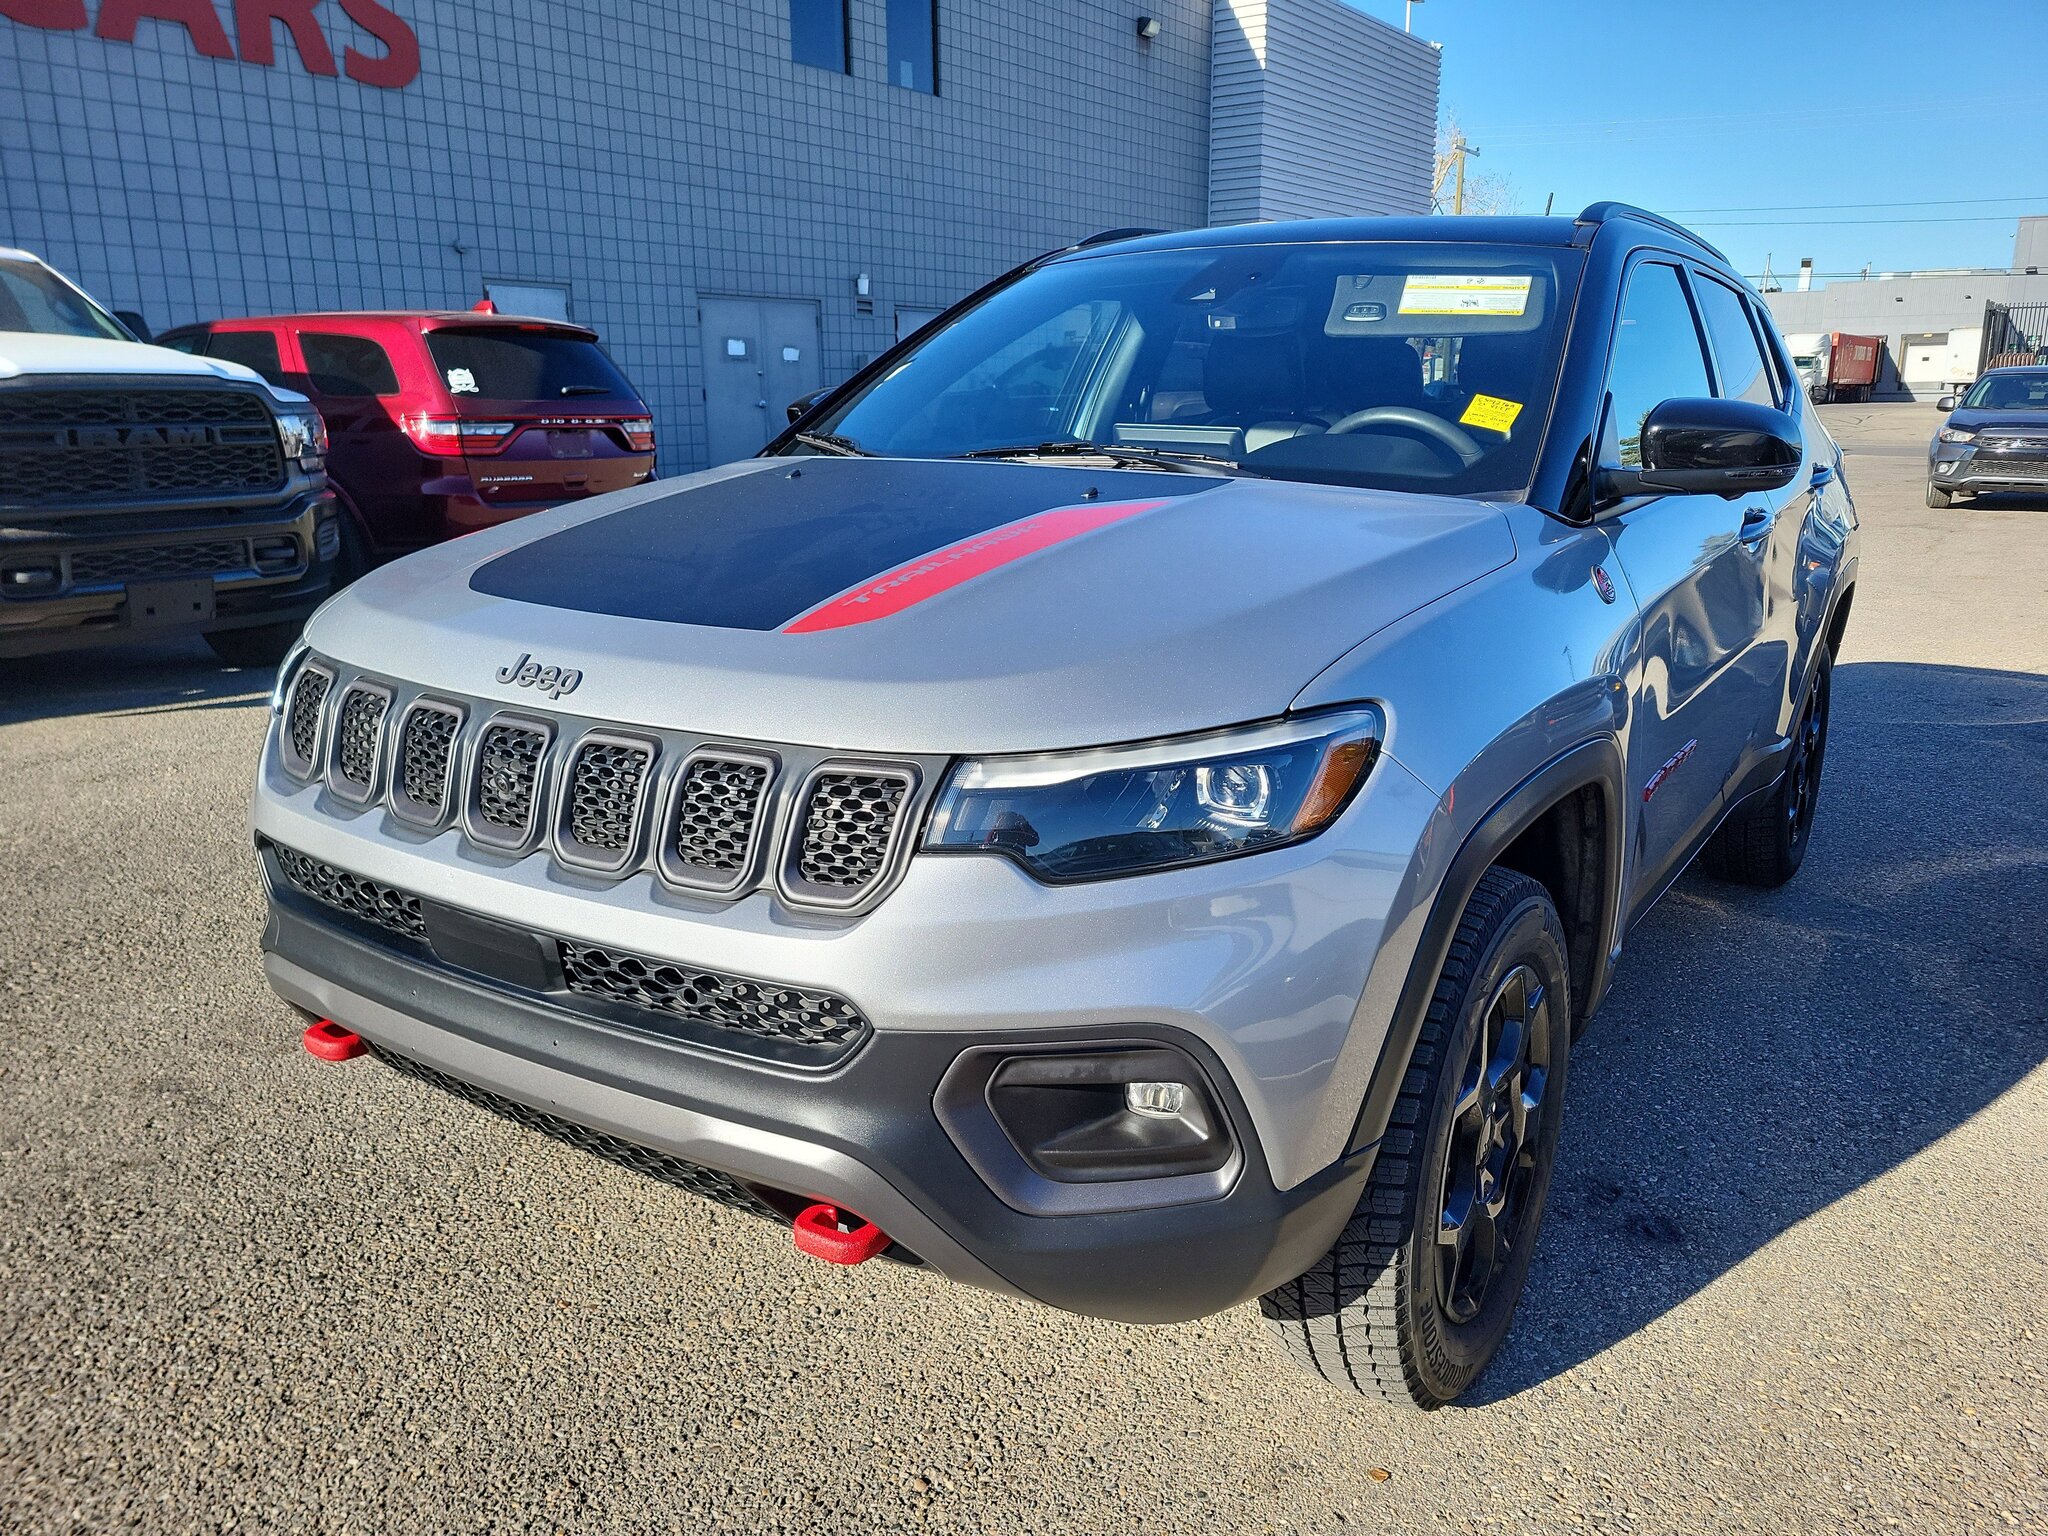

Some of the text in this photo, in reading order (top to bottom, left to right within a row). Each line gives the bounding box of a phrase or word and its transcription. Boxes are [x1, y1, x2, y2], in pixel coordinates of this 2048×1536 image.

[75, 424, 205, 449] RAM
[841, 521, 1045, 607] TRAILHAWK
[495, 652, 583, 700] Jeep
